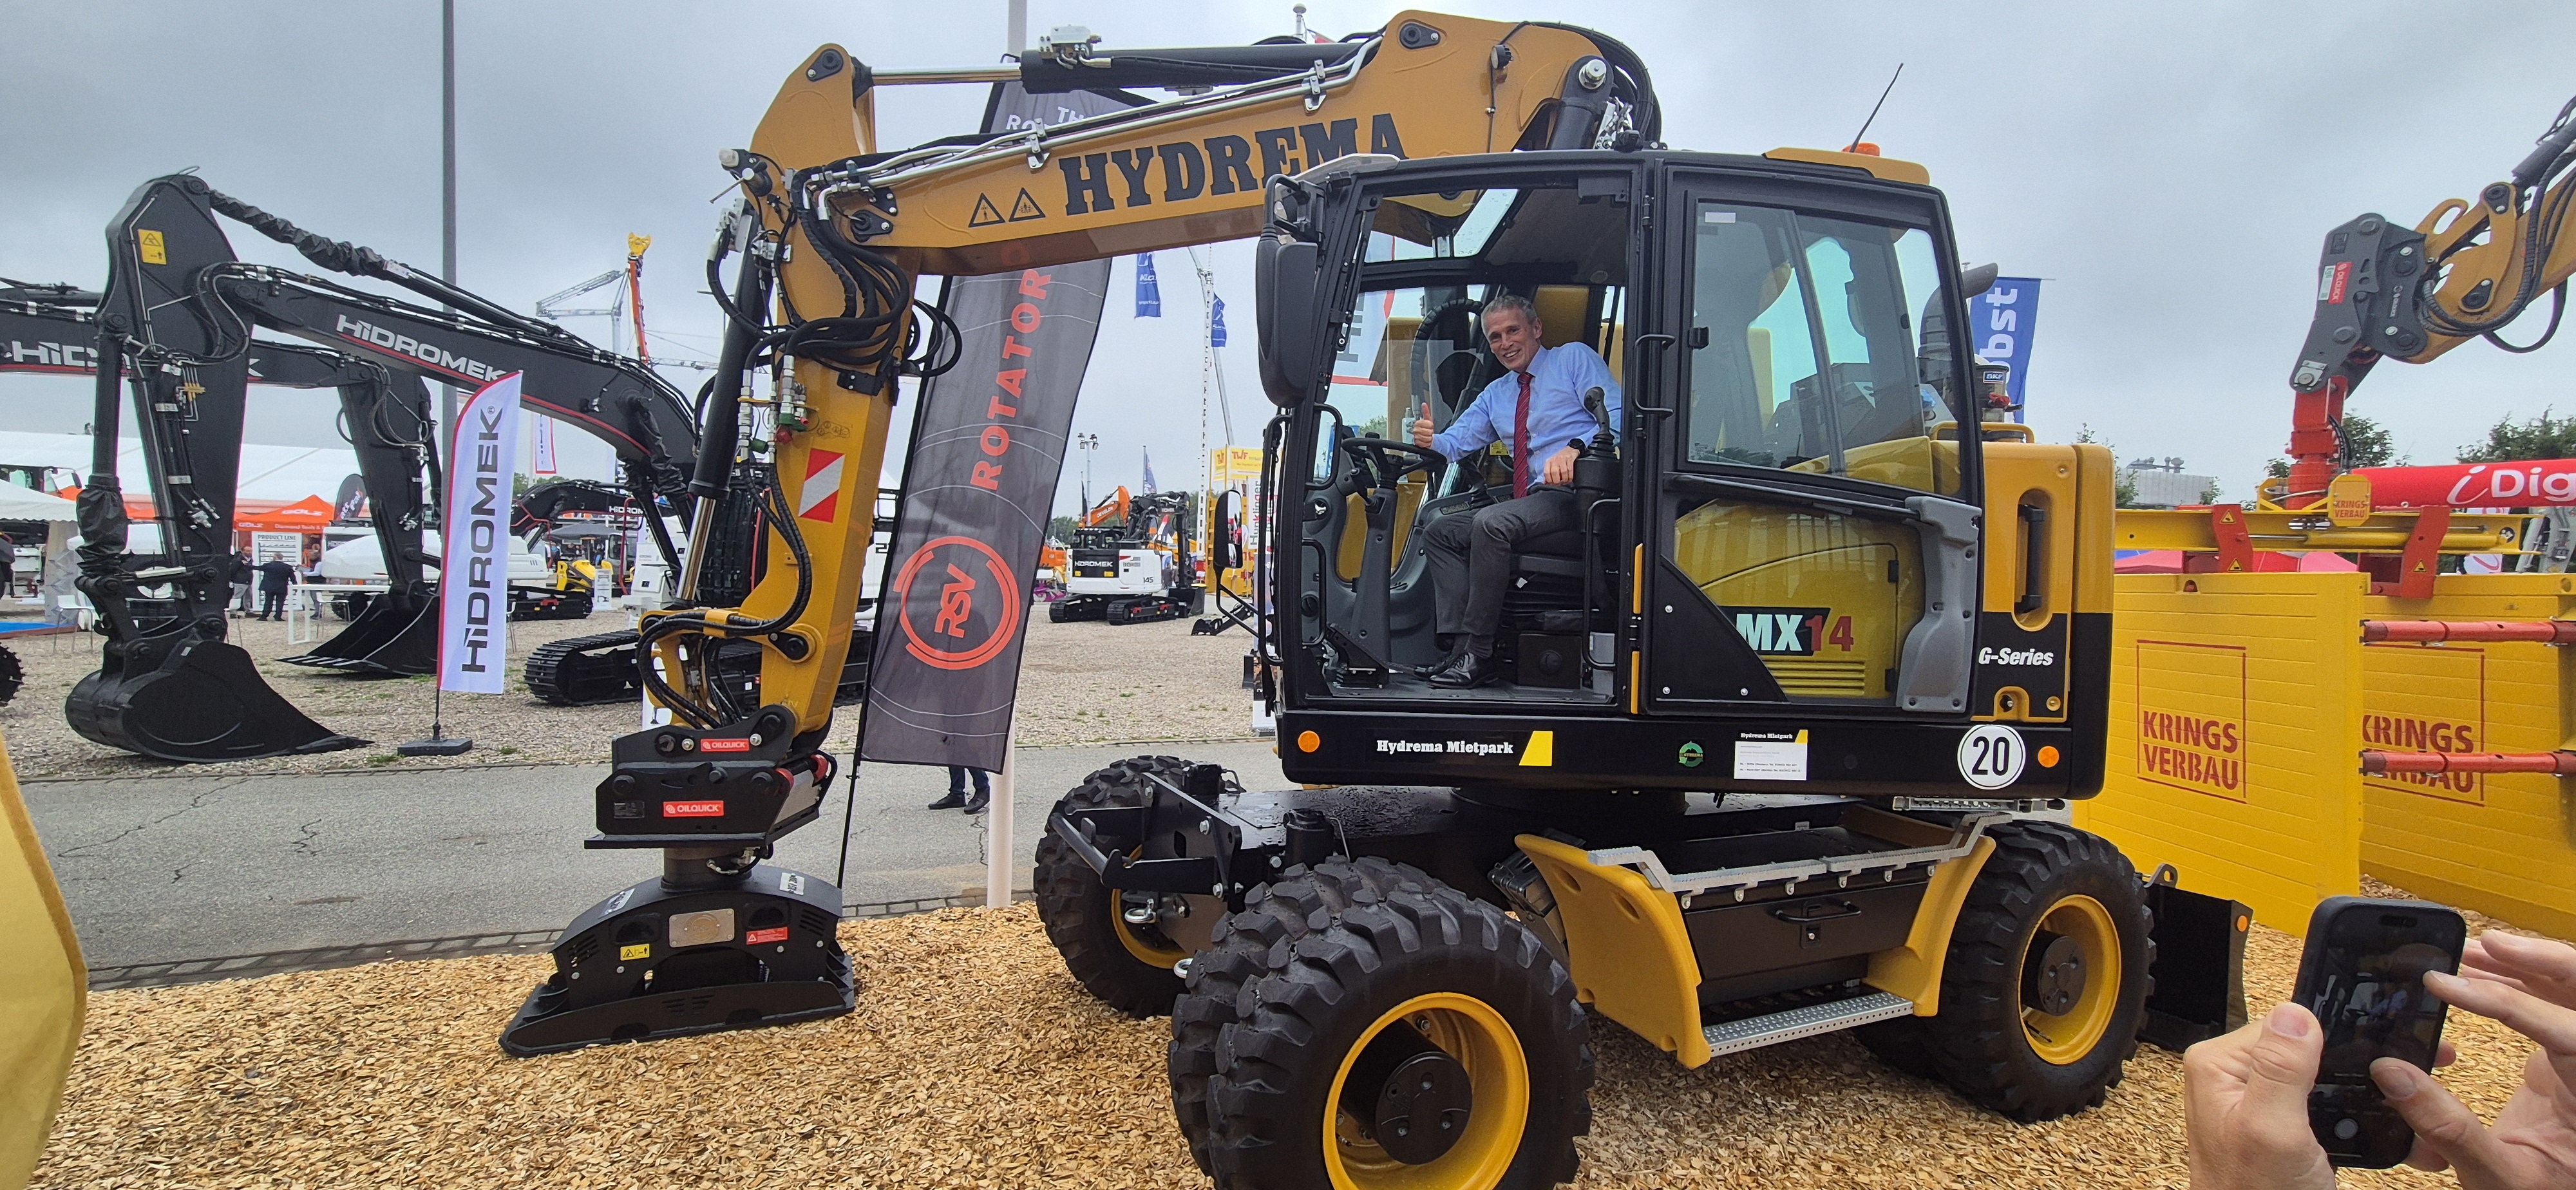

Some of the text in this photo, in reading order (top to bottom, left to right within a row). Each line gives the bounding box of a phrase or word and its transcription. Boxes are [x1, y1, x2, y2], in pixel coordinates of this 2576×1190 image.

[1058, 113, 1409, 216] HYDREMA
[970, 269, 1052, 491] ROTATOR
[2334, 509, 2365, 518] VERBAU
[2335, 500, 2365, 509] KRINGS
[1736, 613, 1855, 652] MX14
[1978, 647, 2054, 666] G-Series
[1376, 740, 1514, 756] Hydrema Mietpark
[2143, 710, 2239, 753] KRINGS
[1971, 735, 2010, 776] 20
[2143, 743, 2239, 791] VERBAU
